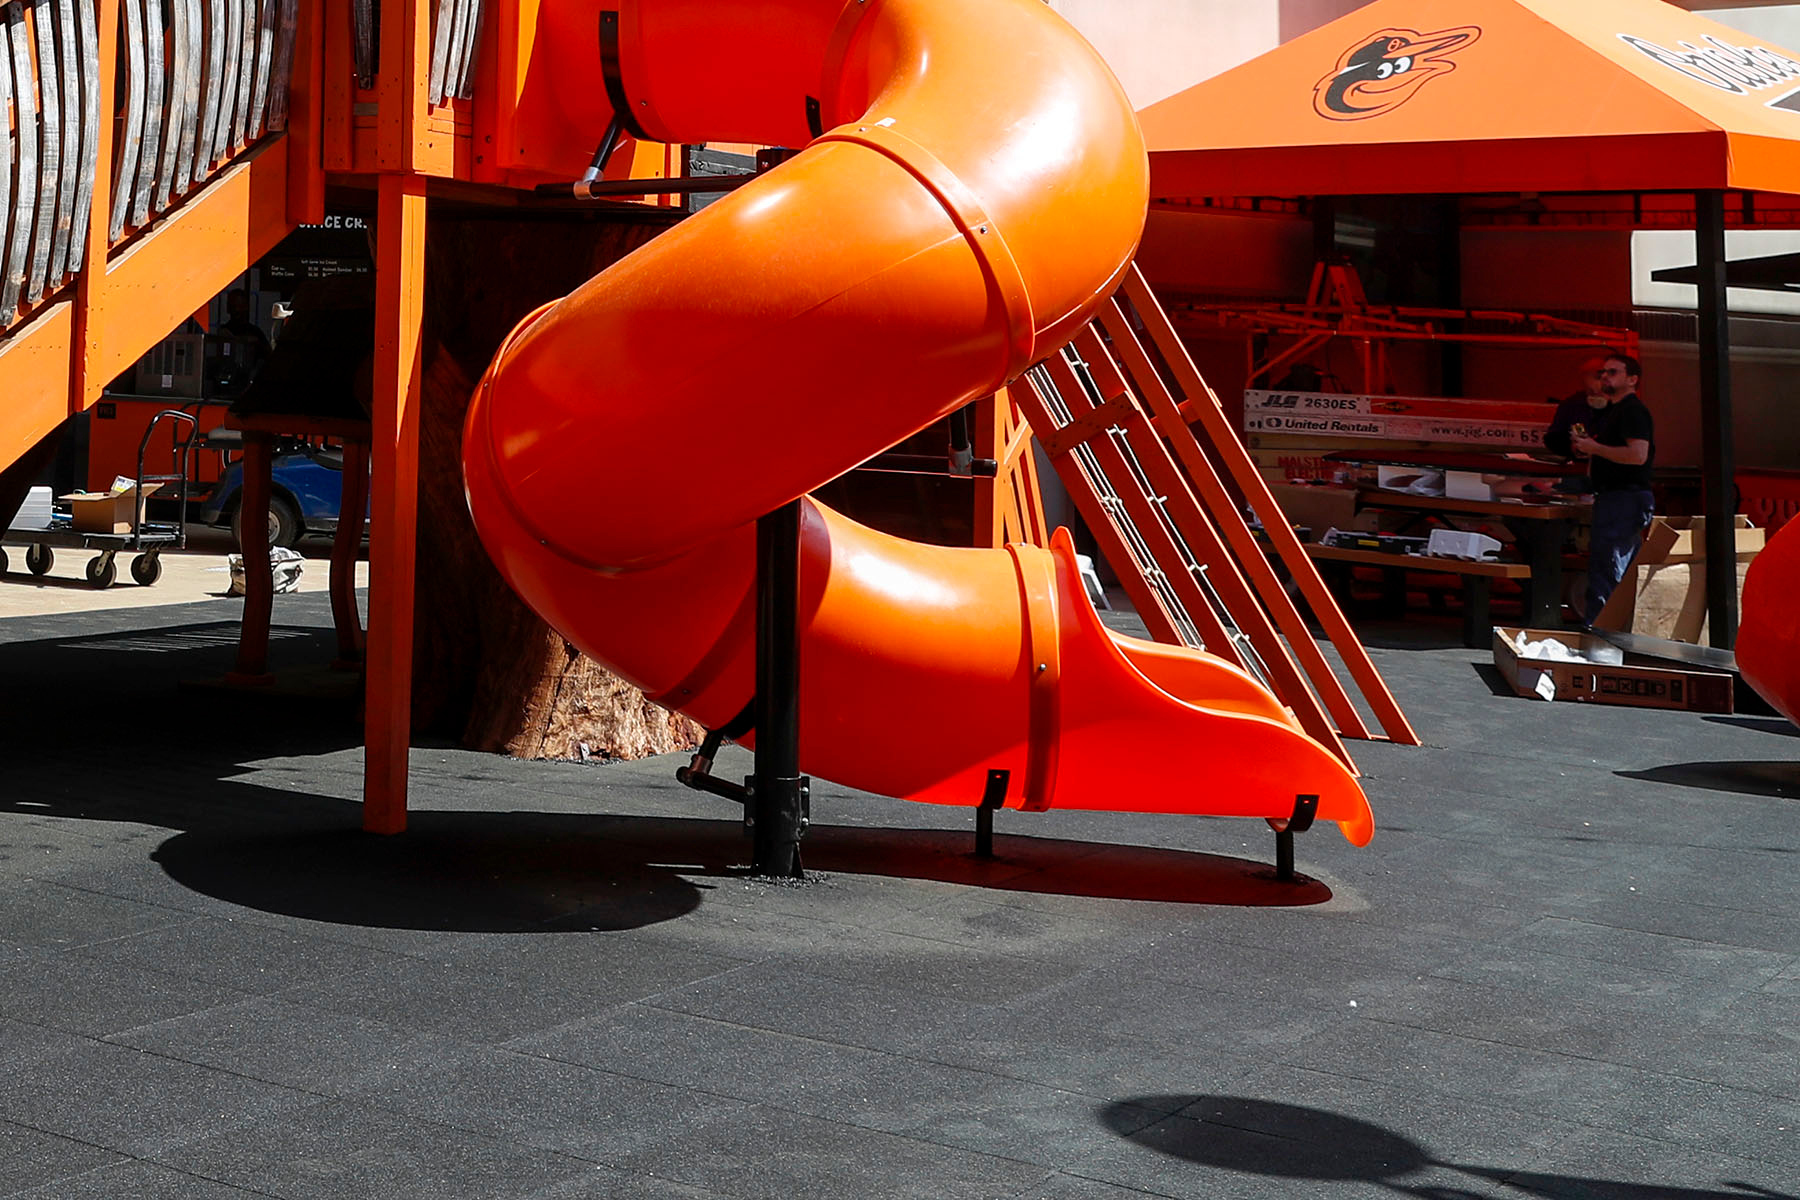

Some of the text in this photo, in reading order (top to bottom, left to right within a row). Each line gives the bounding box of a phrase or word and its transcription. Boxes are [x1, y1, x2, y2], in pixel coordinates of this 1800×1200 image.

[1305, 397, 1357, 410] 2630ES
[1285, 418, 1328, 430] United
[1331, 420, 1379, 433] Rentals
